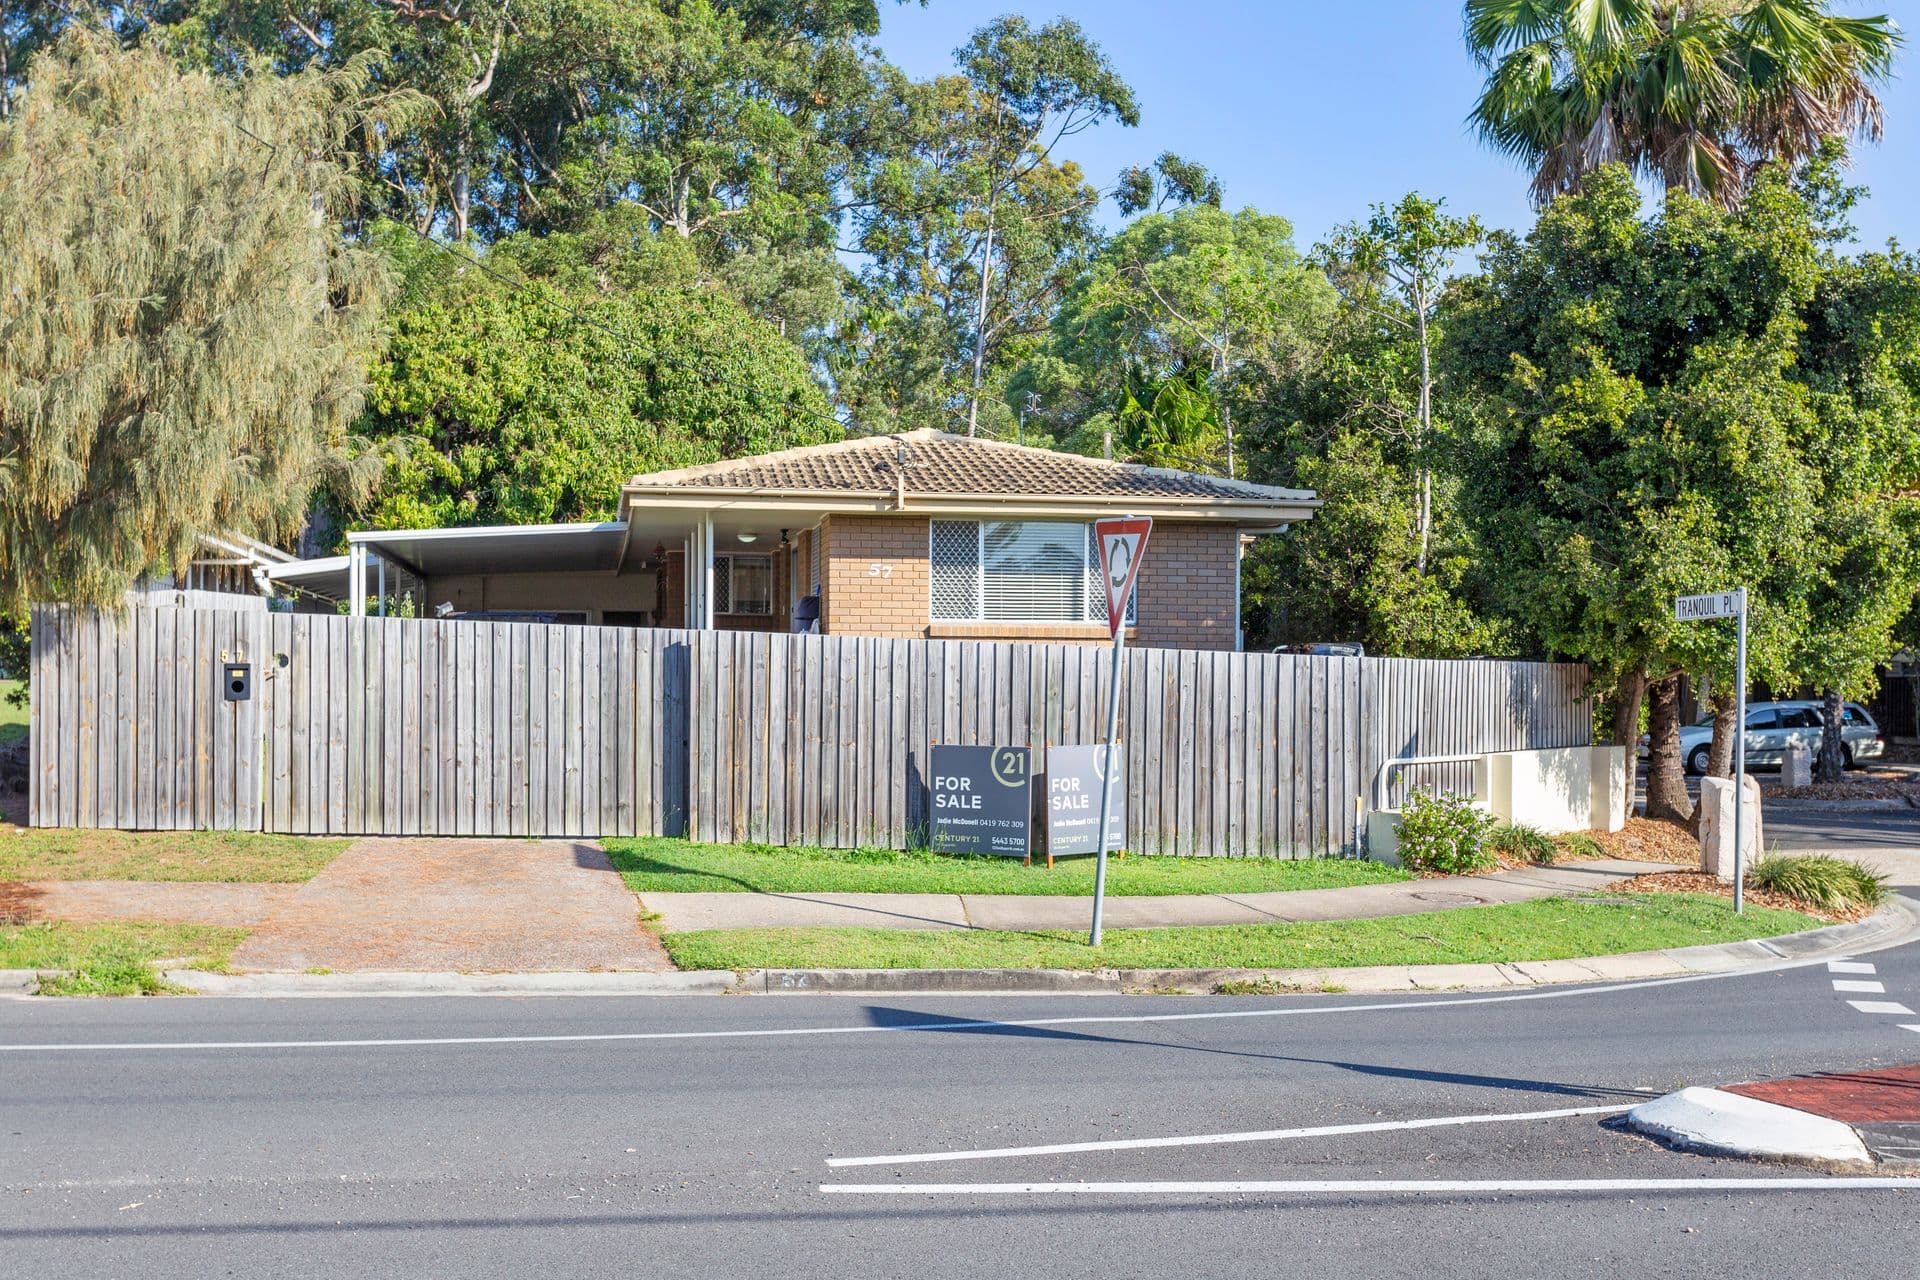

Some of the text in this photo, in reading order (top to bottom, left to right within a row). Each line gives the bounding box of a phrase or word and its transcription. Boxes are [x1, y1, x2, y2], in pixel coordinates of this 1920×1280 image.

[868, 563, 894, 579] 57
[1678, 595, 1734, 618] TRANQUIL PL
[935, 776, 971, 791] FOR
[1052, 777, 1081, 792] FOR
[935, 794, 982, 809] SALE
[1052, 794, 1089, 810] SALE
[979, 819, 997, 827] 0419
[997, 820, 1010, 828] 762
[1010, 820, 1025, 829] 309
[935, 833, 971, 843] CENTURY
[991, 836, 1025, 846] 5443 5700
[1053, 835, 1082, 845] CENTURY
